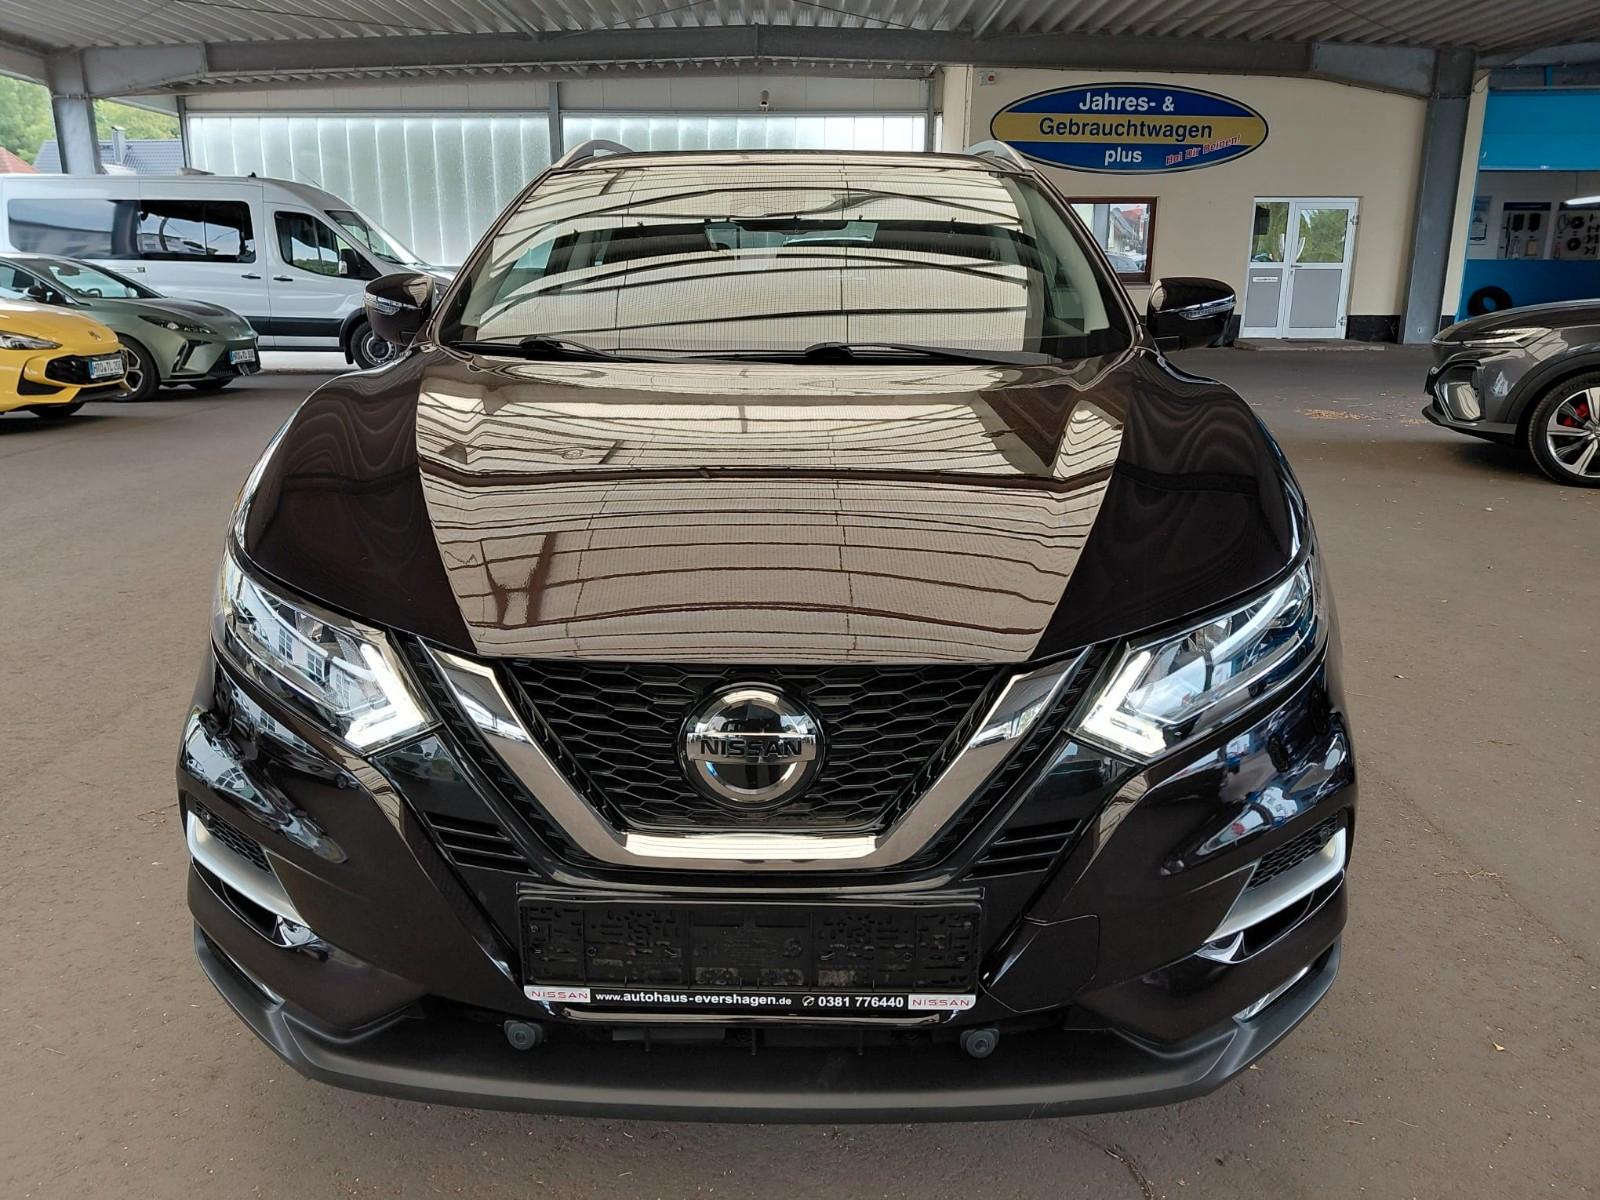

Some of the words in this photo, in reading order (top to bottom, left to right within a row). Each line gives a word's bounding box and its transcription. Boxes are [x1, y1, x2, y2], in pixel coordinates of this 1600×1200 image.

[1079, 92, 1156, 111] Jahres-
[1162, 96, 1175, 112] &
[1039, 117, 1213, 143] Gebrauchtwagen
[1104, 147, 1143, 166] plus
[700, 738, 803, 756] NISSAN
[531, 991, 588, 999] NISSAN
[595, 991, 792, 1007] www.autohaus-evershagen.de
[818, 996, 850, 1008] 0381
[855, 997, 904, 1008] 776440
[912, 999, 969, 1007] NISSAN
